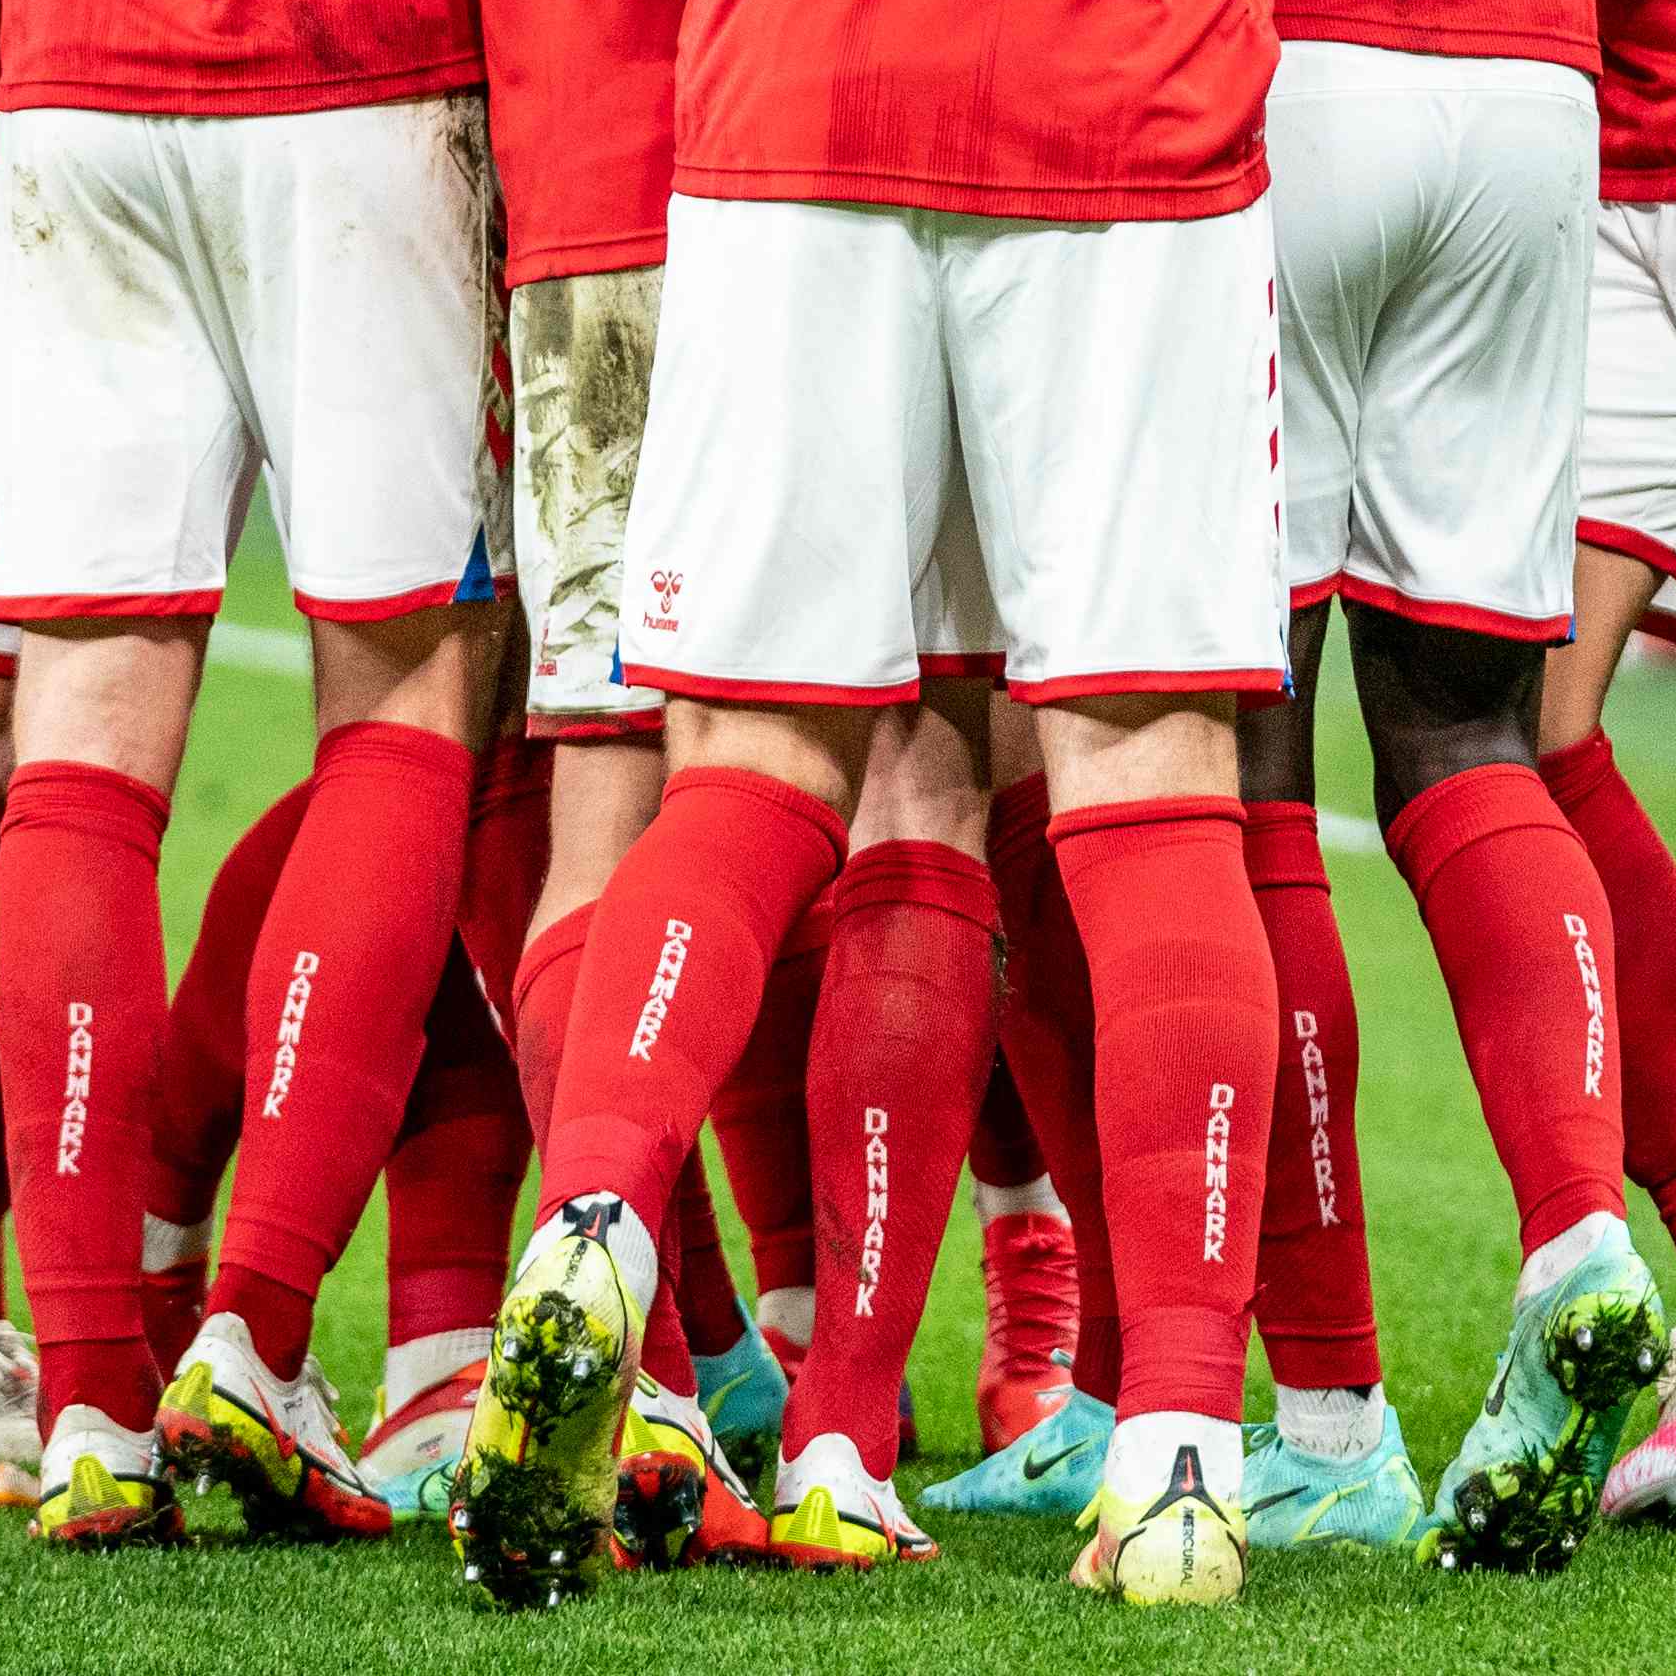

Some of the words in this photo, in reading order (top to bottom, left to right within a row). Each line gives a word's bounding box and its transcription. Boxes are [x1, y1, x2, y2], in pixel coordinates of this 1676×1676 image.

[262, 950, 320, 1119] DANMARK
[629, 918, 693, 1061] DANMARK
[1563, 913, 1605, 1099] DANMARK
[57, 1002, 93, 1175] DANMARK
[1204, 1082, 1235, 1262] DANMARK
[1294, 1010, 1341, 1228] DANMARK
[855, 1107, 888, 1316] DANMARK
